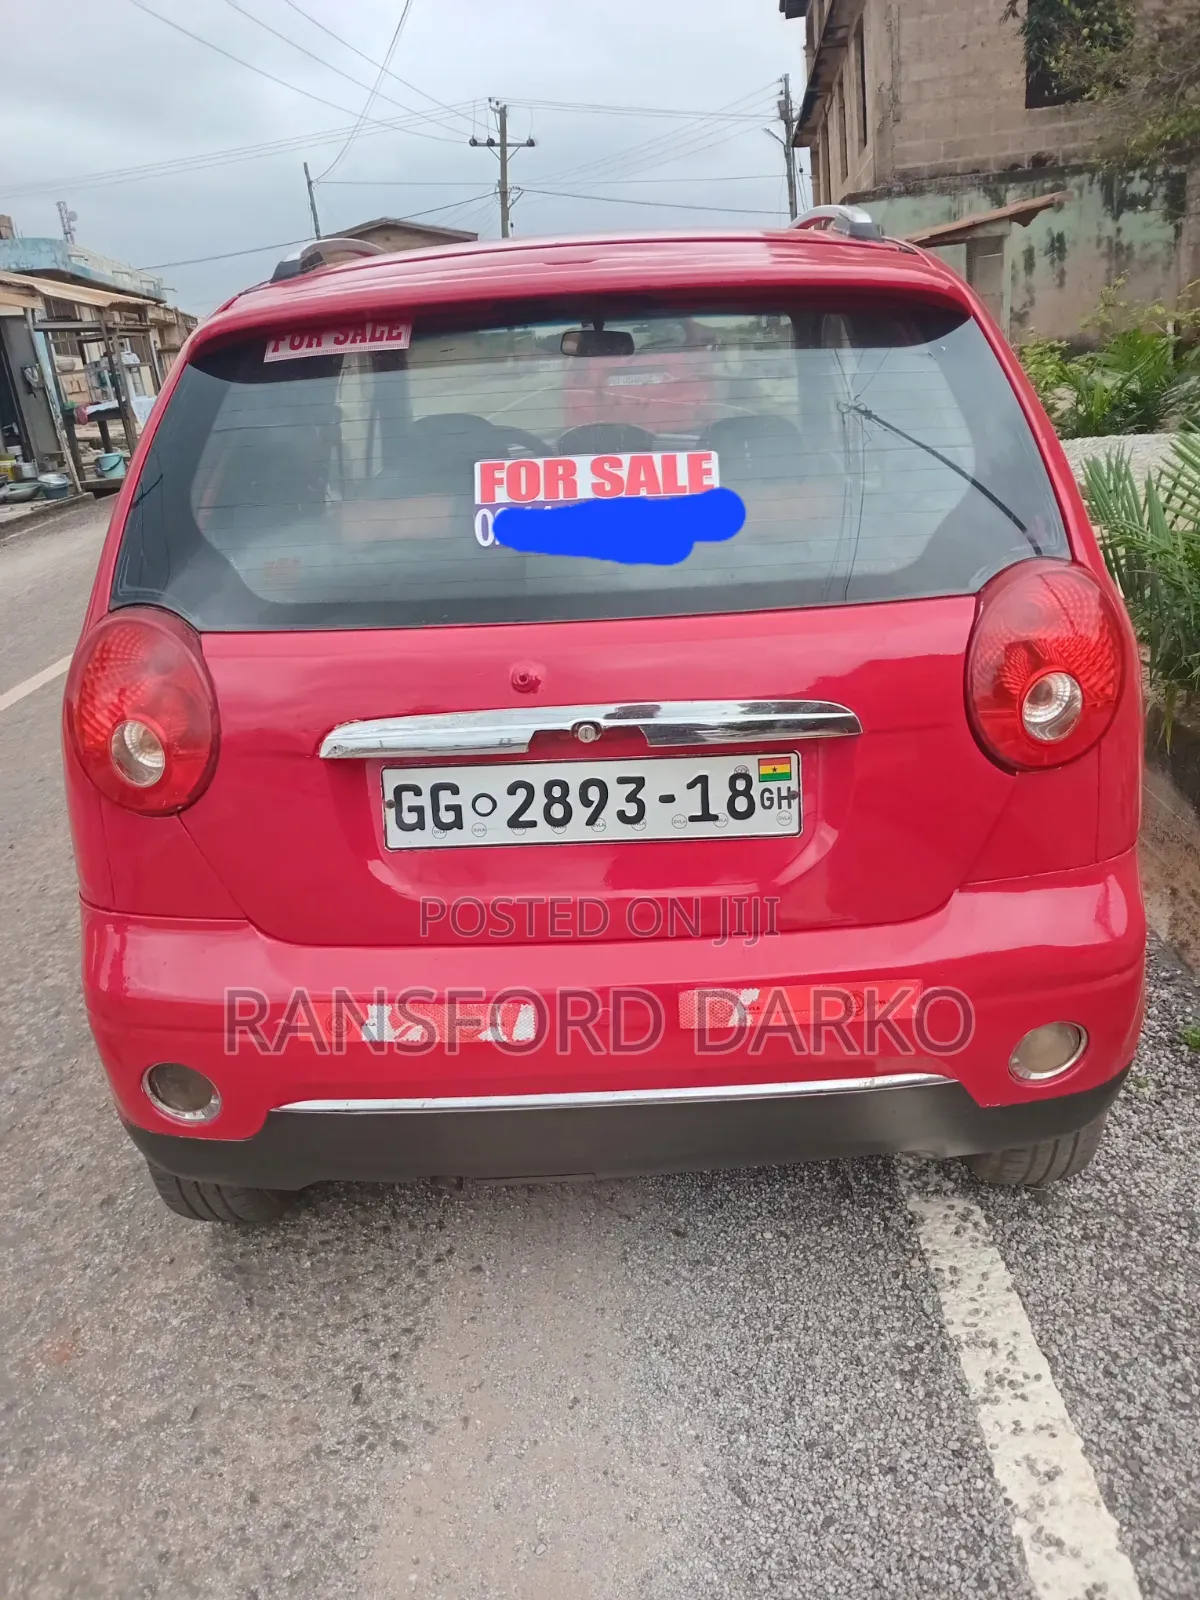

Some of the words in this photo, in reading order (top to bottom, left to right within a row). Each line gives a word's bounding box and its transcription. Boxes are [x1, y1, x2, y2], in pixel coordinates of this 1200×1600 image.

[480, 459, 578, 503] FOR
[590, 452, 715, 499] SALE
[393, 781, 464, 831] GG
[506, 773, 756, 828] 2893-18
[760, 786, 792, 810] GH
